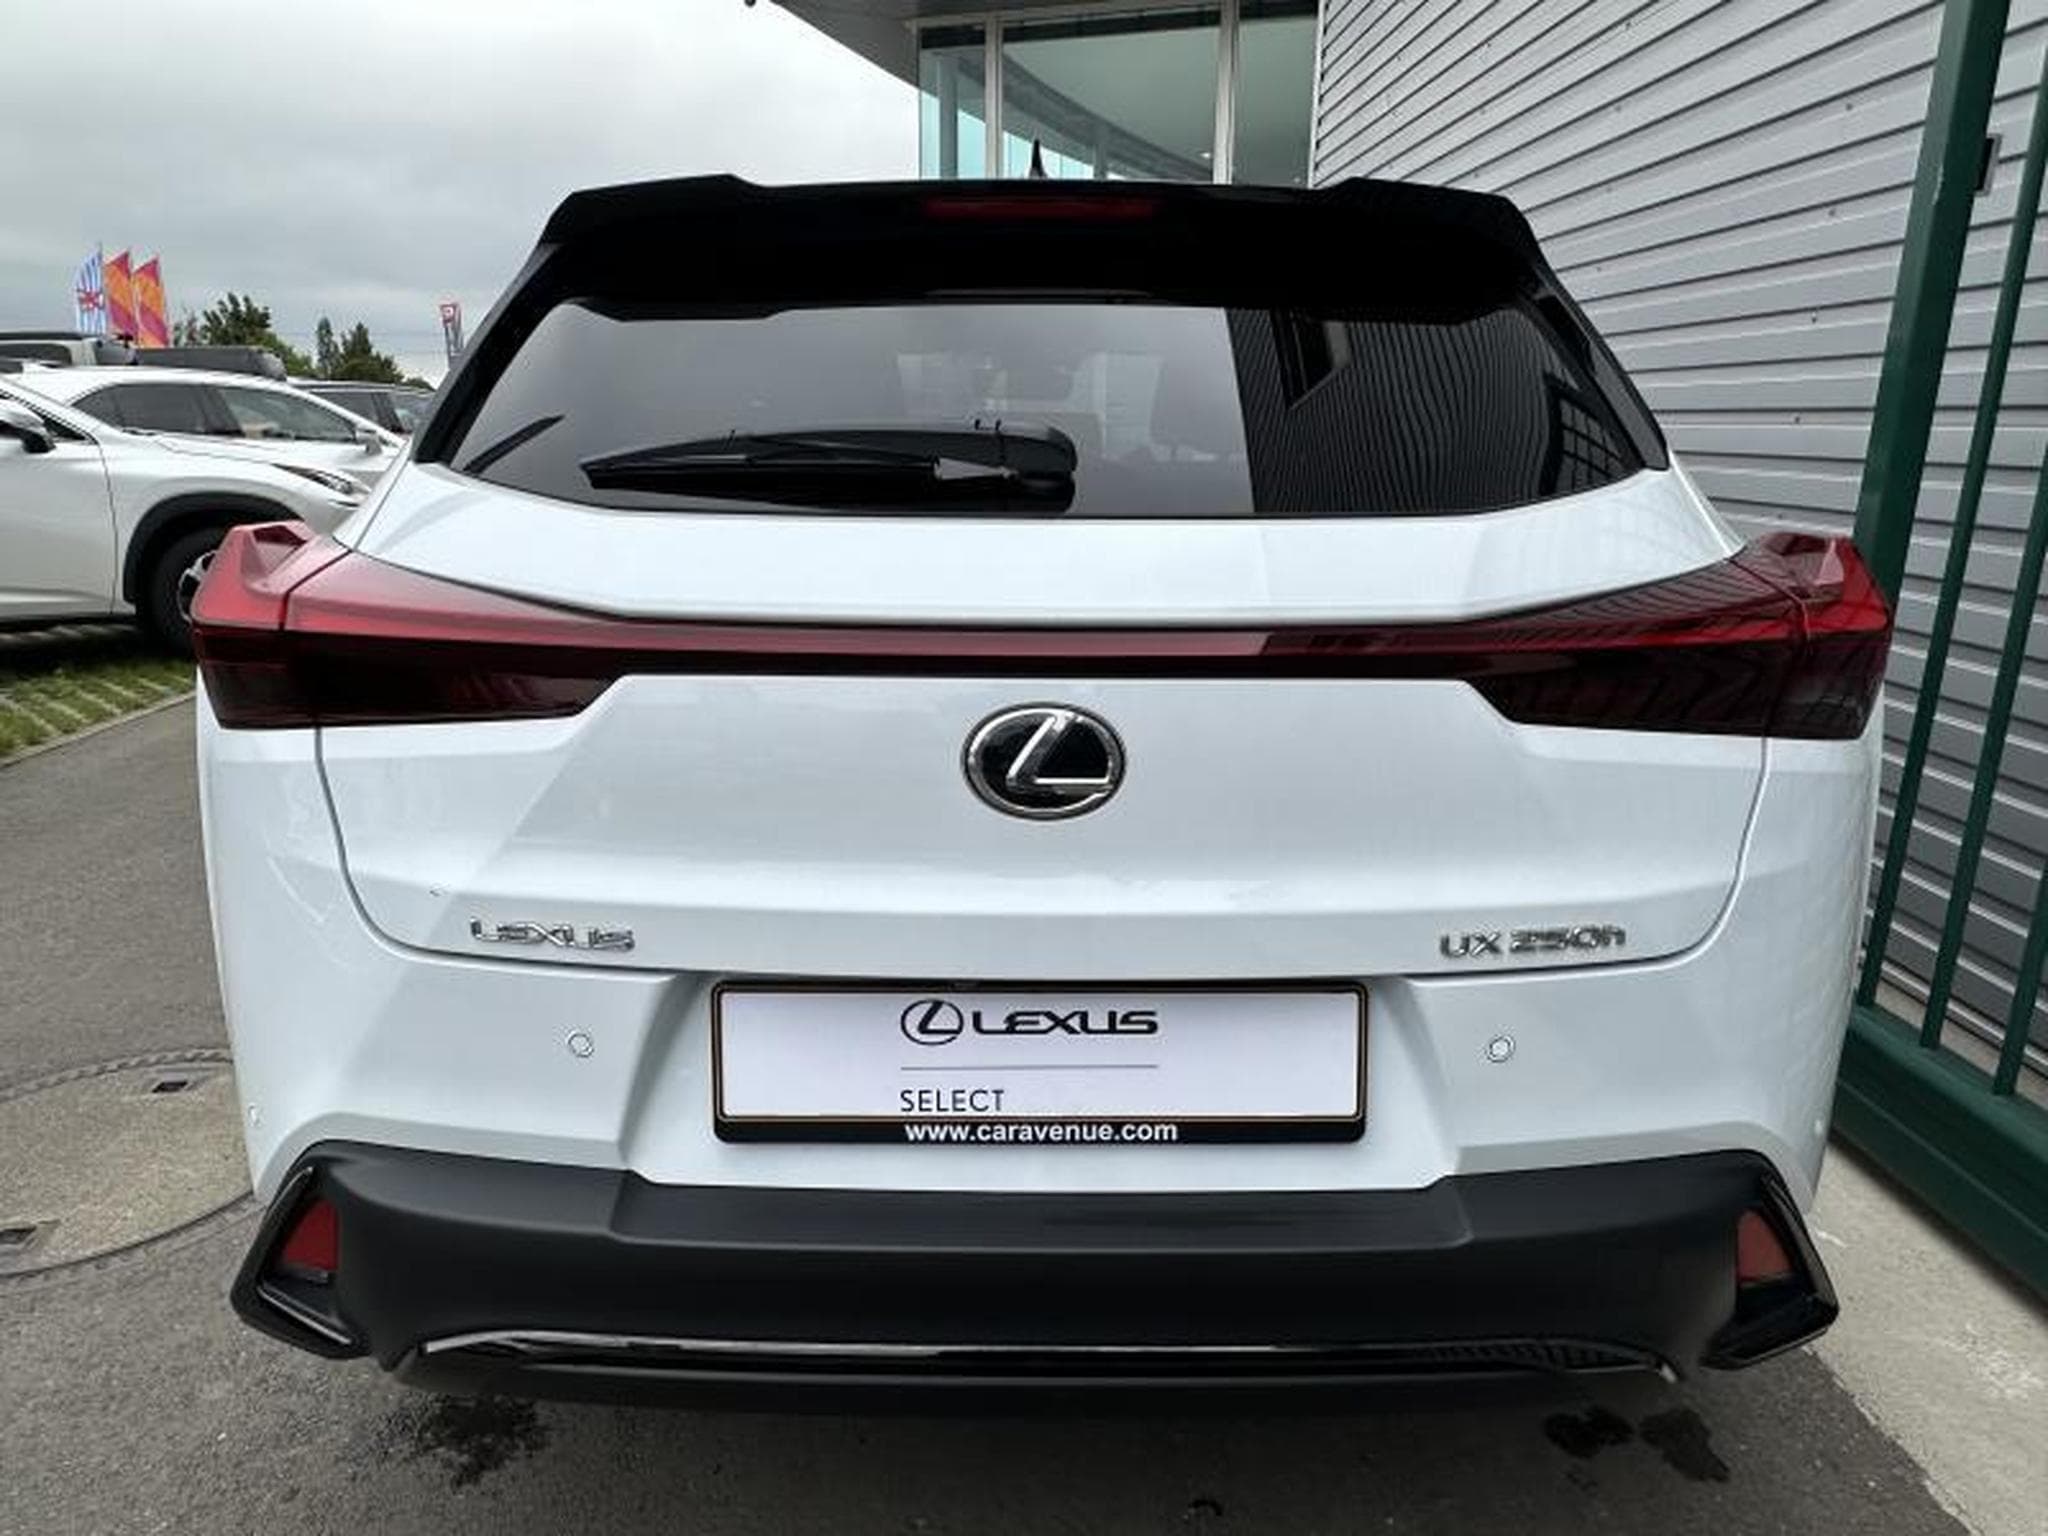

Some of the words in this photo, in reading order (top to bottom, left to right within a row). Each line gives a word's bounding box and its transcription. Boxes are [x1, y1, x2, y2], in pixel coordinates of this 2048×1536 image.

[469, 916, 635, 951] LEXUS
[1440, 930, 1501, 957] UX
[1509, 925, 1626, 954] 250h
[972, 1010, 1158, 1035] LEXUS
[900, 1089, 1005, 1112] SELECT
[904, 1123, 1178, 1142] www.caravenue.com
